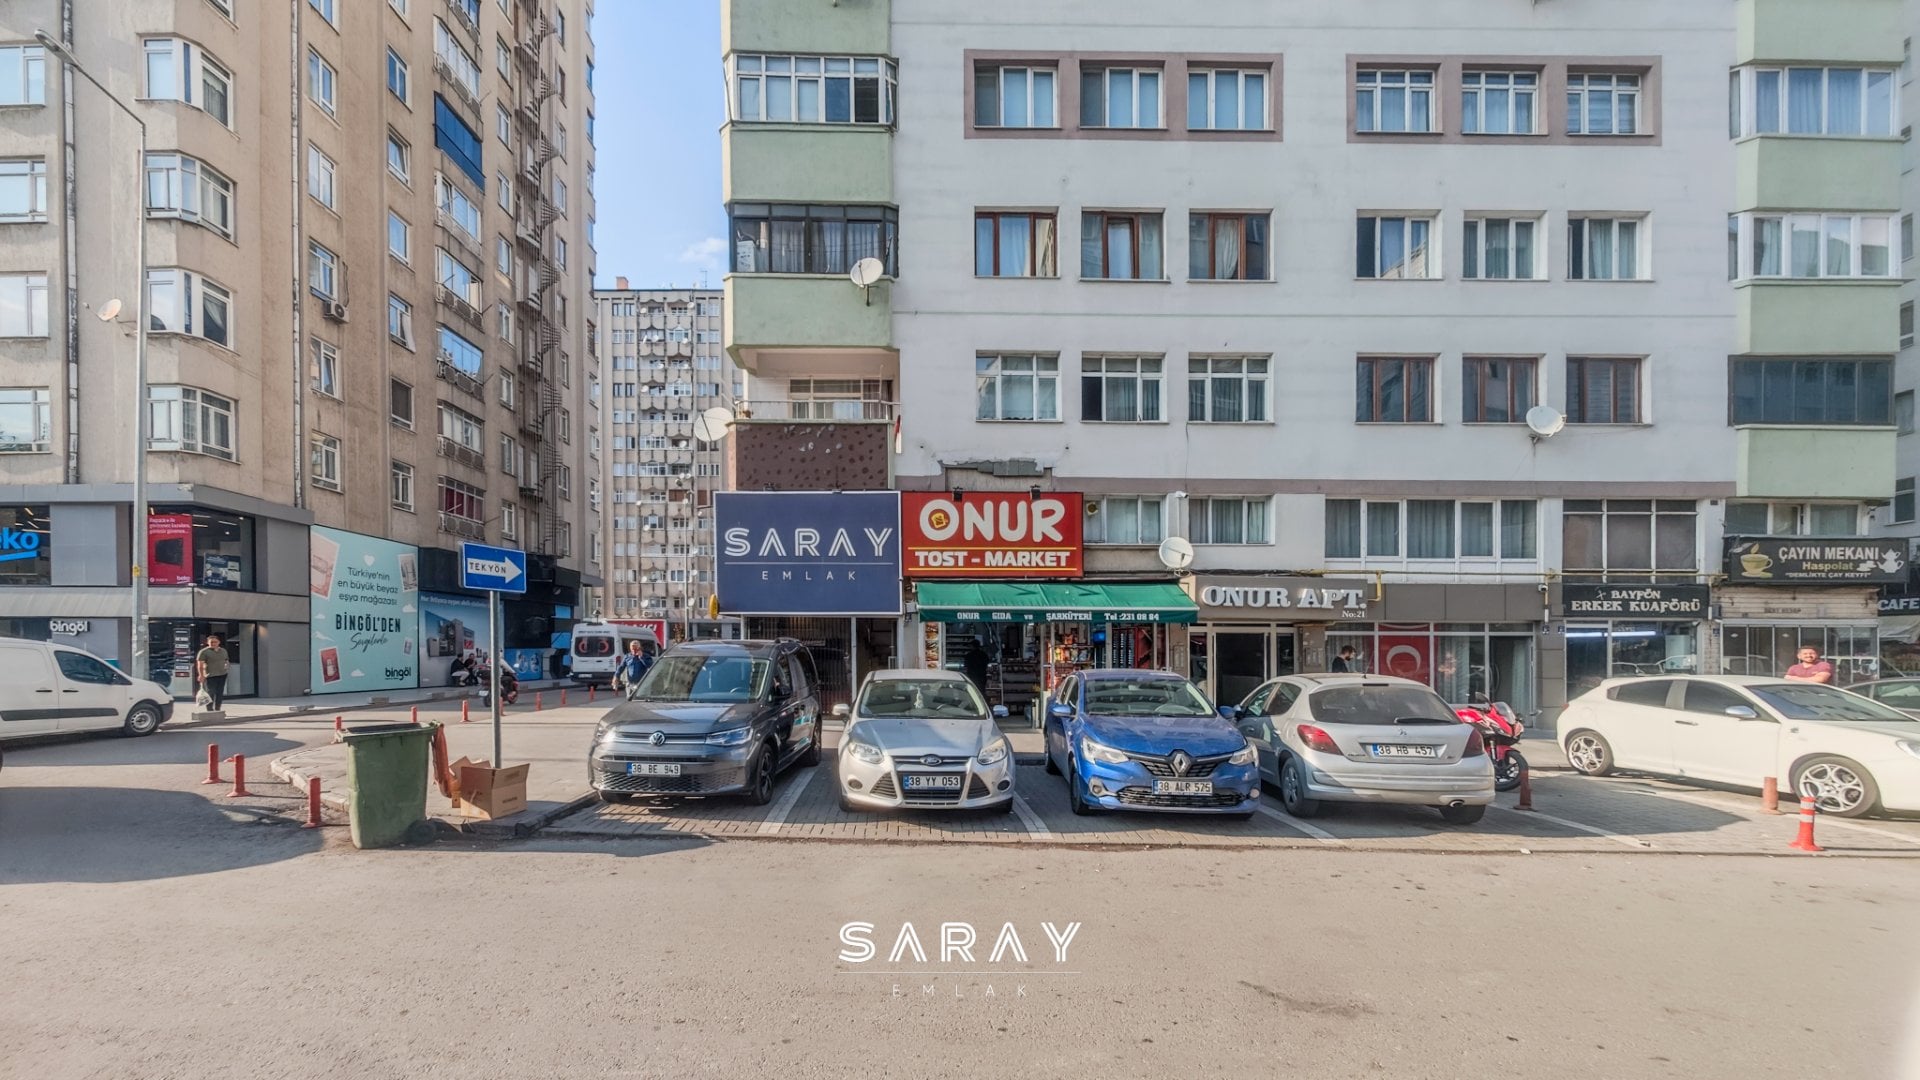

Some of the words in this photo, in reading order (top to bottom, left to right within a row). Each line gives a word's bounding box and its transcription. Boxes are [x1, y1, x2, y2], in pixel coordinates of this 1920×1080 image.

[919, 499, 1066, 543] ONUR
[724, 527, 893, 557] SARAY
[915, 551, 968, 567] TOST
[984, 551, 1071, 567] MARKET
[1778, 546, 1821, 563] ÇAYIN
[1824, 546, 1879, 560] MEKANI
[1802, 561, 1853, 572] Haspolat
[761, 570, 856, 581] EMLAK
[337, 580, 348, 588] en
[350, 580, 375, 592] büyük
[376, 583, 399, 595] beyaz
[339, 593, 359, 603] eşya
[1202, 585, 1291, 608] ONUR
[1297, 588, 1367, 609] APT.
[1571, 600, 1623, 612] ERKEK
[1629, 599, 1701, 613] KUAFÖRÜ
[1877, 598, 1920, 611] CAFE
[957, 612, 980, 620] ONUR
[992, 612, 1012, 620] GIDA
[1046, 611, 1093, 622] ŞARKÜTERİ
[1341, 610, 1366, 618] No:21
[50, 620, 88, 636] bingöl
[335, 611, 401, 633] BİNGÖL'DEN
[385, 667, 411, 681] bingöl
[1379, 745, 1391, 755] 38
[1415, 746, 1433, 756] 457
[910, 776, 921, 786] 38
[926, 776, 936, 786] YY
[942, 776, 959, 786] 053
[1159, 781, 1170, 791] 38
[1175, 782, 1191, 791] ALR
